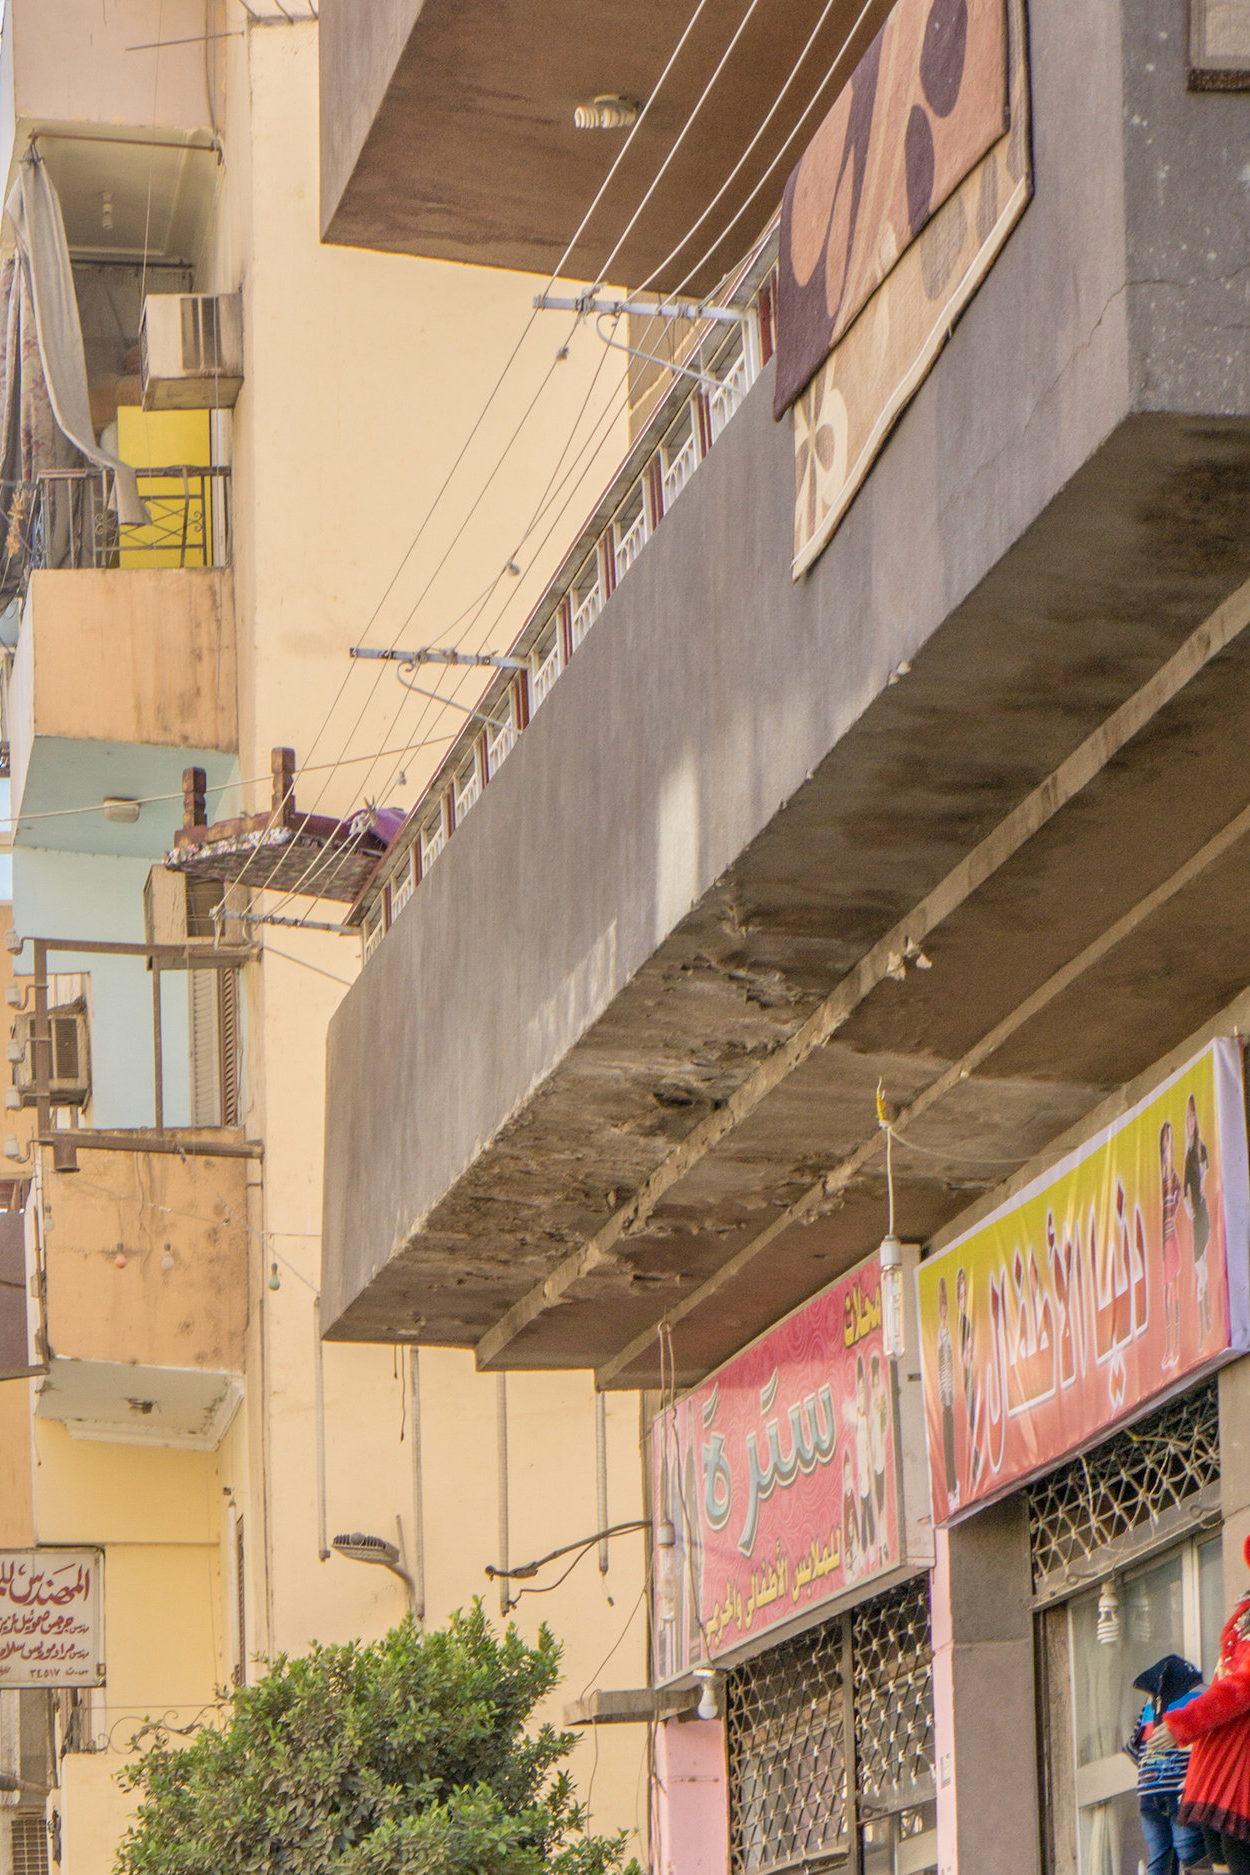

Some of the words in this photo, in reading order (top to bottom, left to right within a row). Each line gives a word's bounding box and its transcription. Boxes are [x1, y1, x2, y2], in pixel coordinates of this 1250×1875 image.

[844, 1279, 882, 1348] محلات
[1088, 1176, 1149, 1412] دنيا
[9, 1562, 90, 1607] المهندس
[791, 1524, 841, 1603] للملابس
[50, 1643, 75, 1660] مراد
